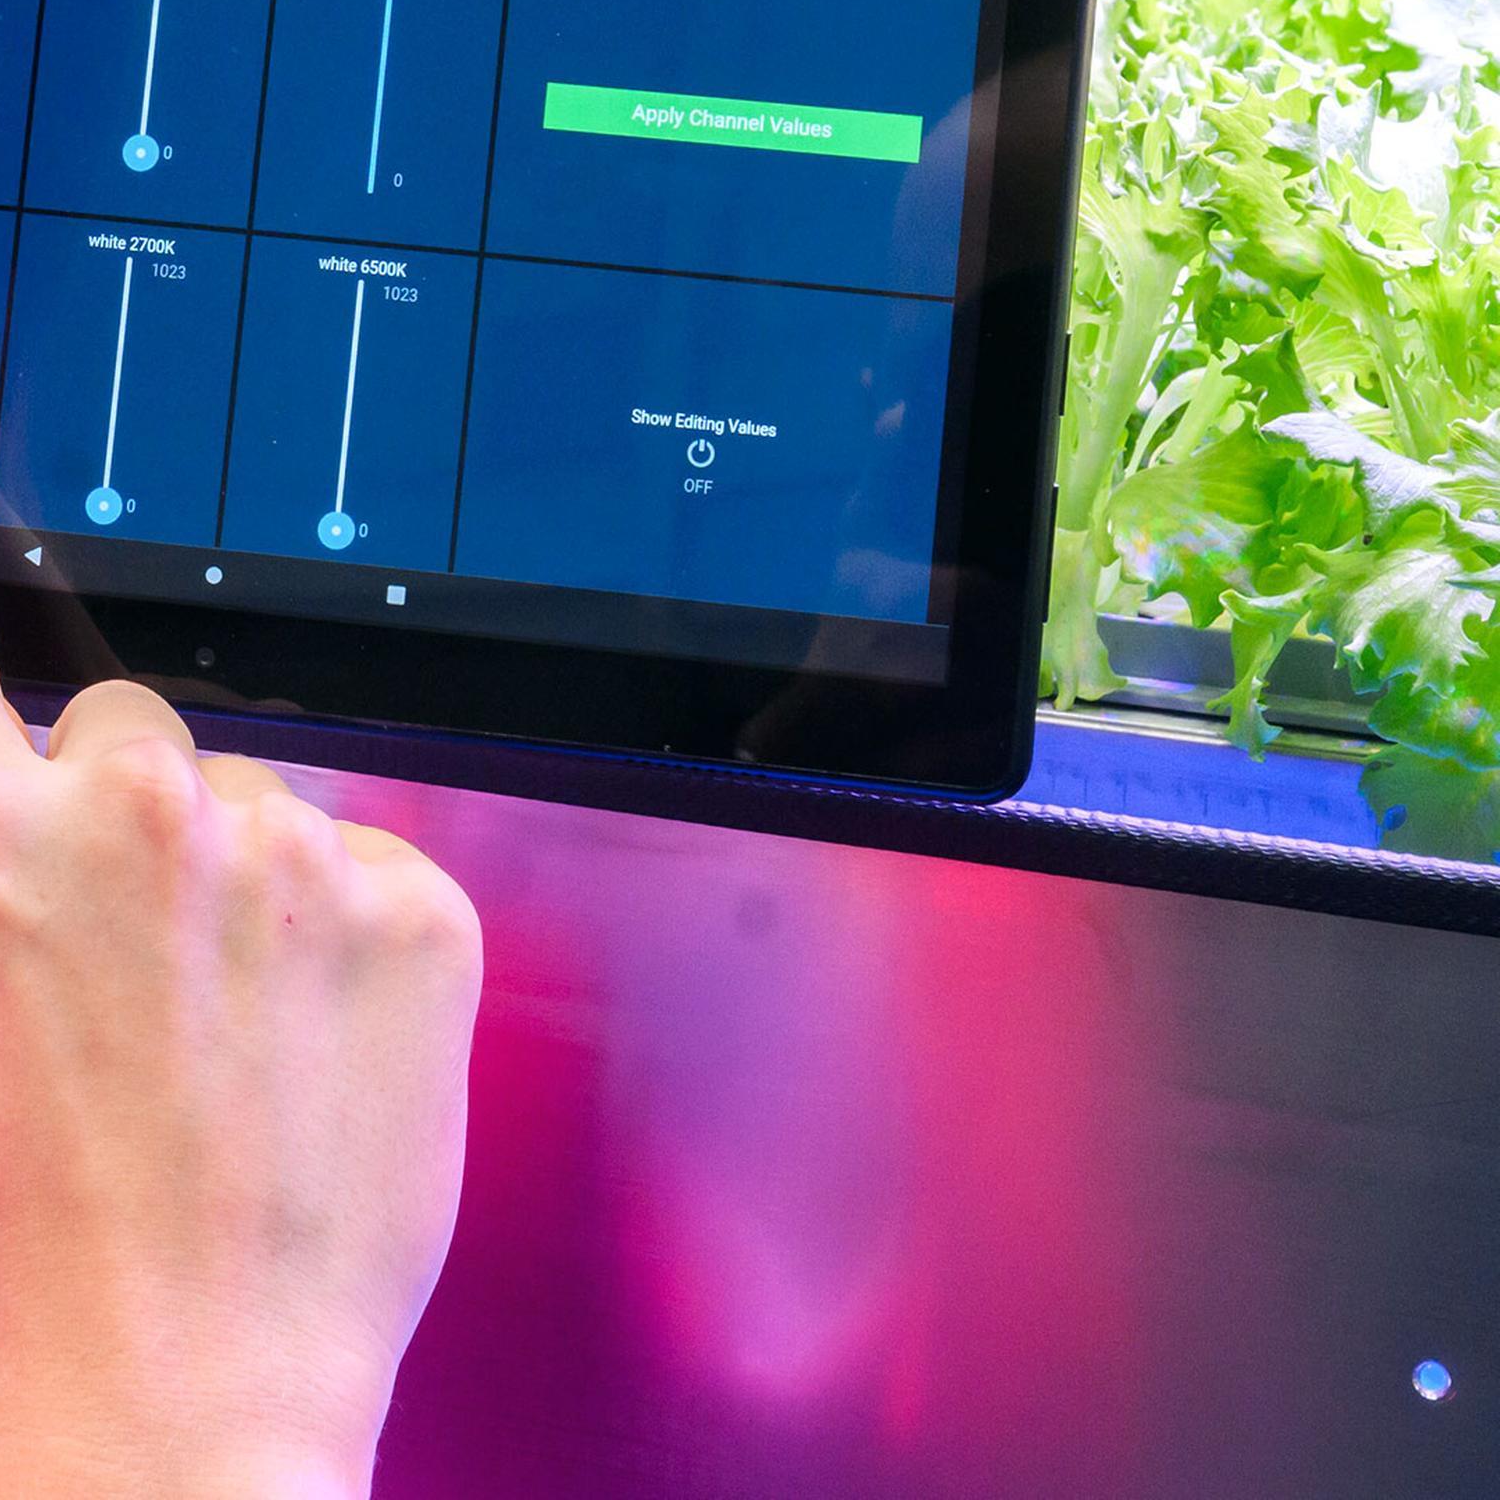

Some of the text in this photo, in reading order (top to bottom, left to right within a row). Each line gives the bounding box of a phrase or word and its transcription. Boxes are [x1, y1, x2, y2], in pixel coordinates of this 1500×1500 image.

[632, 105, 832, 138] Apply Channel Values
[163, 145, 173, 160] 0
[393, 172, 403, 188] 0
[88, 233, 176, 255] white 2700K
[152, 263, 187, 280] 1023
[318, 255, 408, 278] white 6500K
[383, 285, 419, 303] 1023
[631, 408, 777, 438] Show Editing Values
[683, 478, 714, 495] OFF
[126, 498, 136, 513] 0
[358, 522, 369, 538] 0
